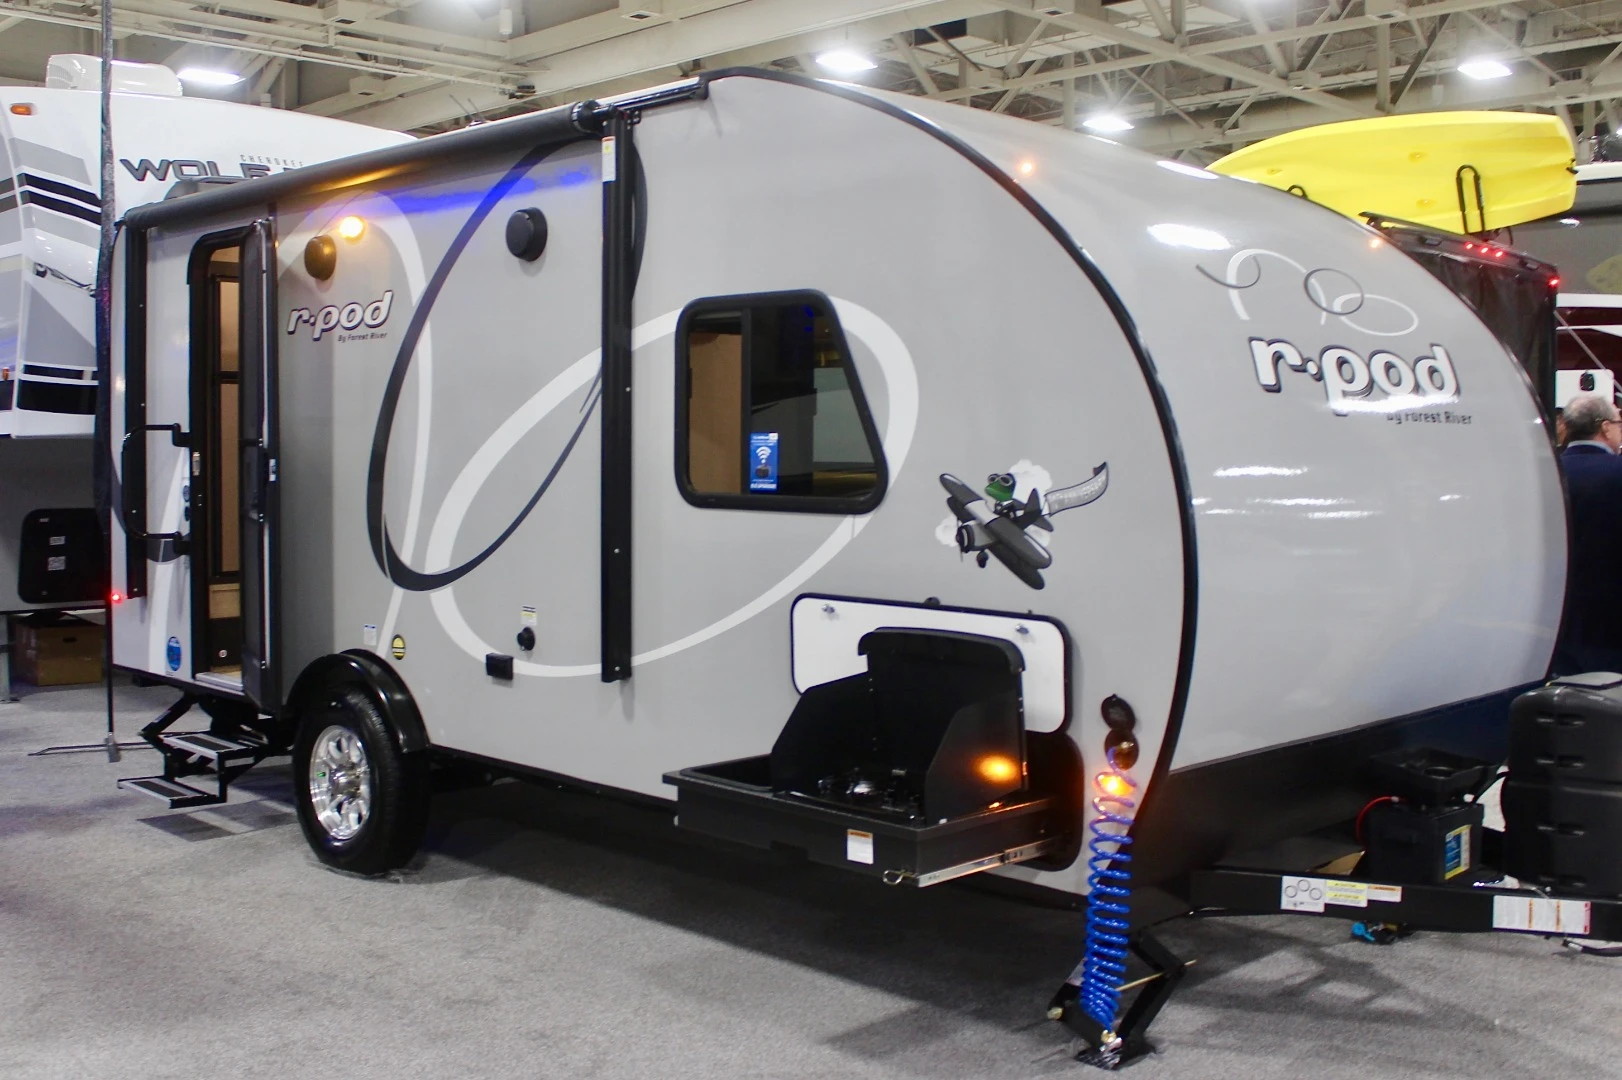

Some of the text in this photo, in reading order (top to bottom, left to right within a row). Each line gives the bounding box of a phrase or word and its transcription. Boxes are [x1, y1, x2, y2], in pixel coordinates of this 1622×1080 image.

[338, 334, 346, 343] By
[347, 333, 368, 341] Forest
[1444, 411, 1472, 425] River
